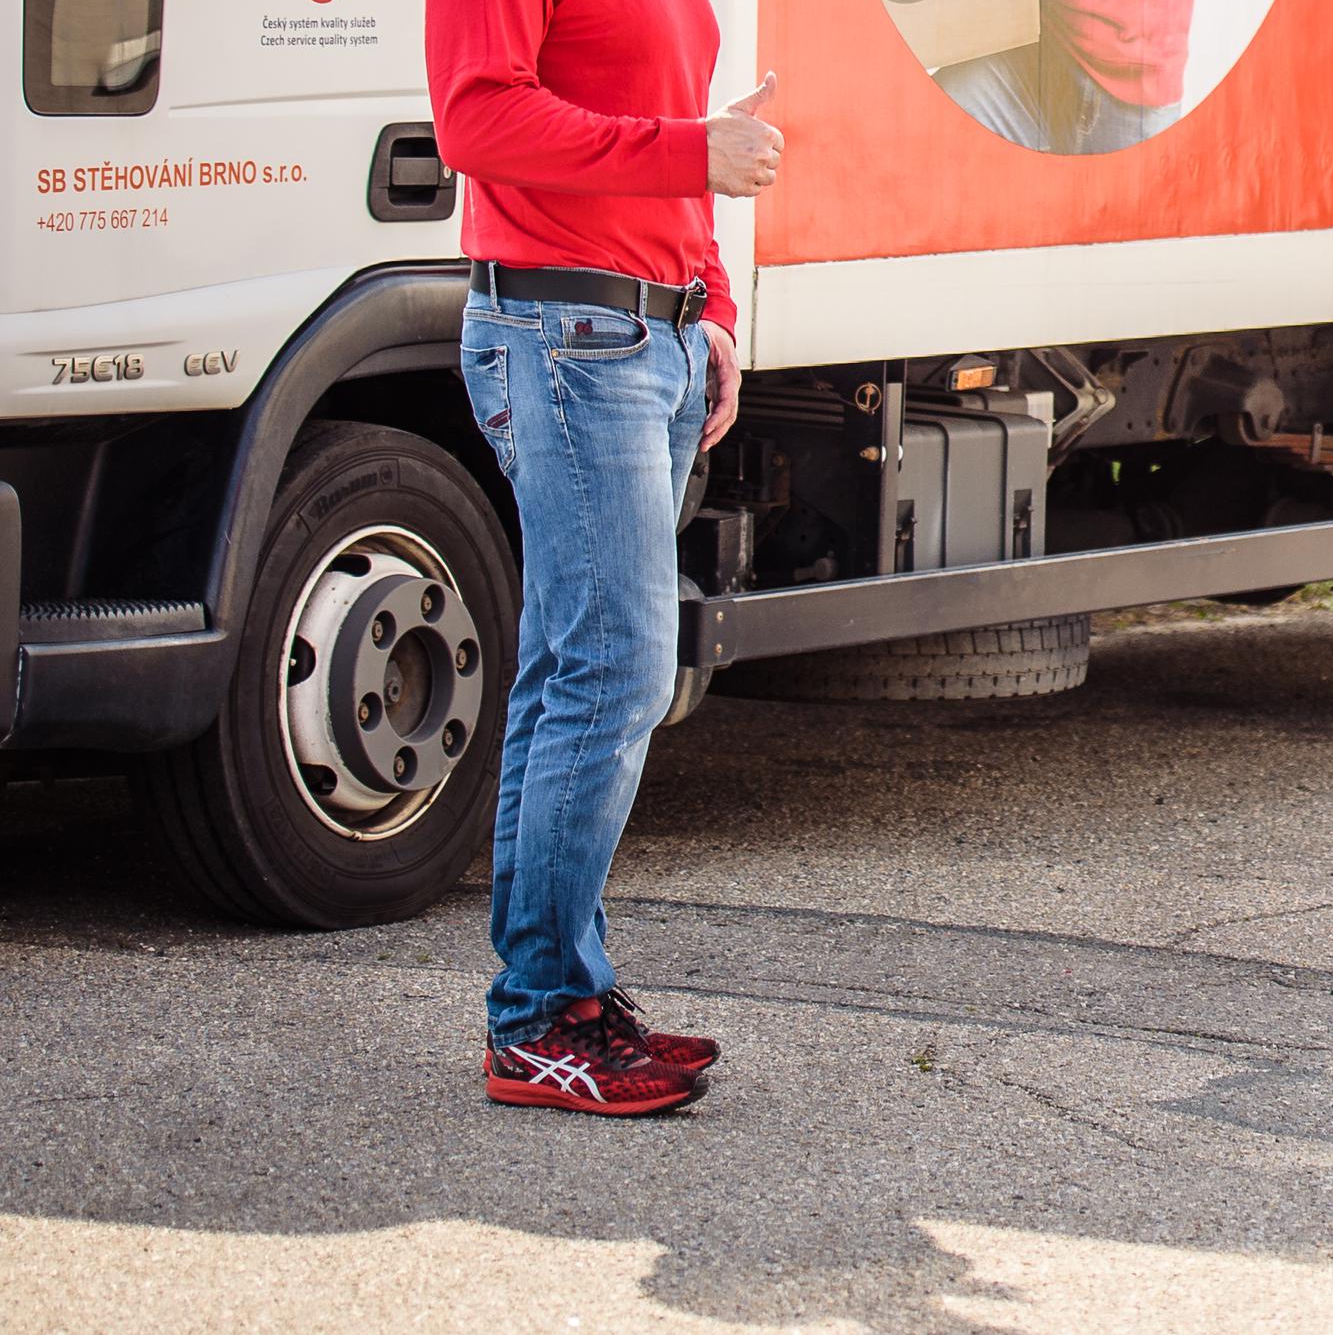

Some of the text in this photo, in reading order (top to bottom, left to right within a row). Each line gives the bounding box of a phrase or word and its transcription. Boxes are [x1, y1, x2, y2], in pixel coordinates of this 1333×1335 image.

[262, 15, 377, 31] Český systém kvality služeb
[260, 34, 378, 48] Czech service quality system
[37, 158, 307, 194] SB STĚHOVÁNÍ BRNO s.r.o.
[36, 208, 168, 232] +420 775 667 214
[52, 349, 241, 385] 75E18 EEV
